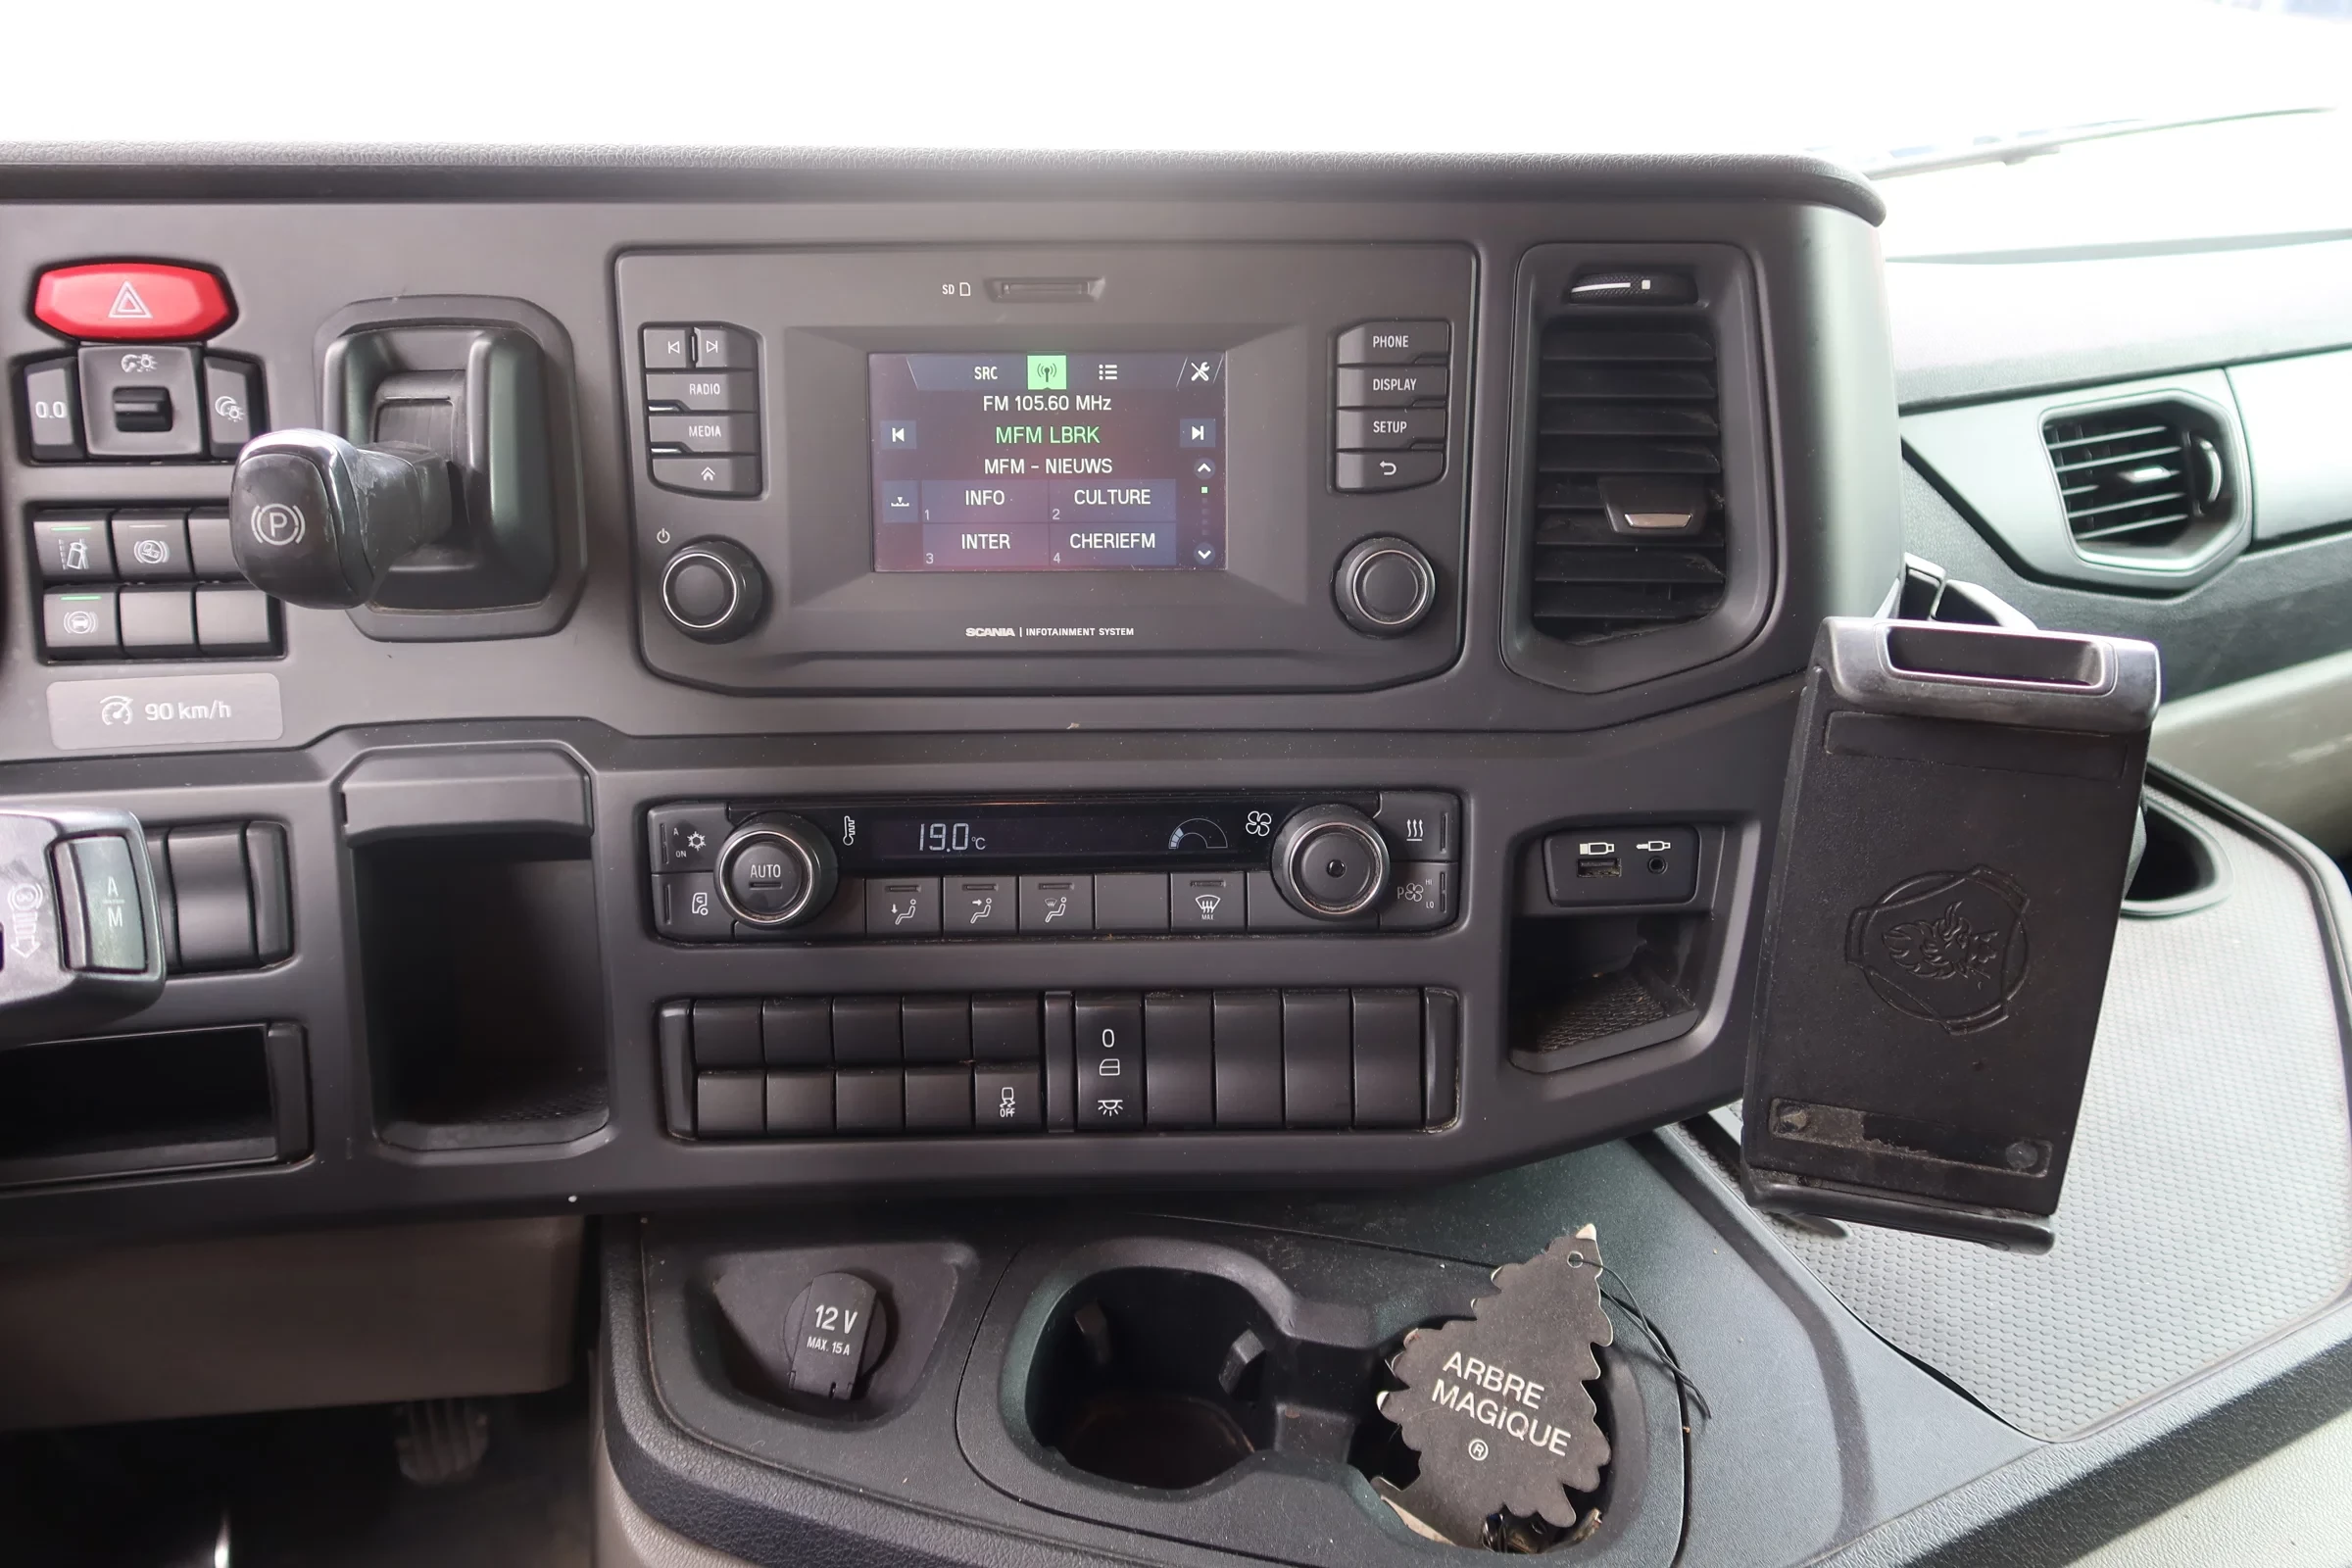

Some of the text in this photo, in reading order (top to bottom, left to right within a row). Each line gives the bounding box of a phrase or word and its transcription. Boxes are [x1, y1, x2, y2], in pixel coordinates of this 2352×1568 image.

[942, 284, 956, 295] SD
[1372, 335, 1409, 348] PHONE
[974, 366, 999, 381] SRC
[689, 383, 720, 396] RADIO
[1373, 378, 1417, 391] DISPLAY
[35, 401, 68, 418] 0.0
[983, 394, 1112, 412] FM 105.60 MHz
[688, 425, 722, 438] MEDIA
[1373, 420, 1407, 433] SETUP
[996, 426, 1101, 444] MFM LBRK
[984, 459, 1025, 474] MFM
[1045, 458, 1113, 474] NIEUWS
[965, 490, 1004, 506] INFO
[1074, 489, 1152, 506] CULTURE
[924, 509, 931, 520] 1
[1052, 509, 1060, 520] 2
[269, 513, 288, 537] P
[961, 533, 1011, 550] INTER
[1069, 532, 1156, 549] CHERIEFM
[925, 553, 934, 564] 3
[1053, 552, 1061, 564] 4
[965, 627, 1135, 637] SCANIA INFOTAINMENT SYSTEM
[144, 700, 232, 721] 90 km/h
[919, 822, 969, 853] 19.0
[750, 863, 781, 878] AUTO
[107, 876, 120, 898] A
[108, 906, 123, 927] M
[999, 1107, 1015, 1118] OFF
[815, 1303, 858, 1334] 12 V
[807, 1336, 829, 1352] MAX.
[1443, 1351, 1545, 1409] ARBRE
